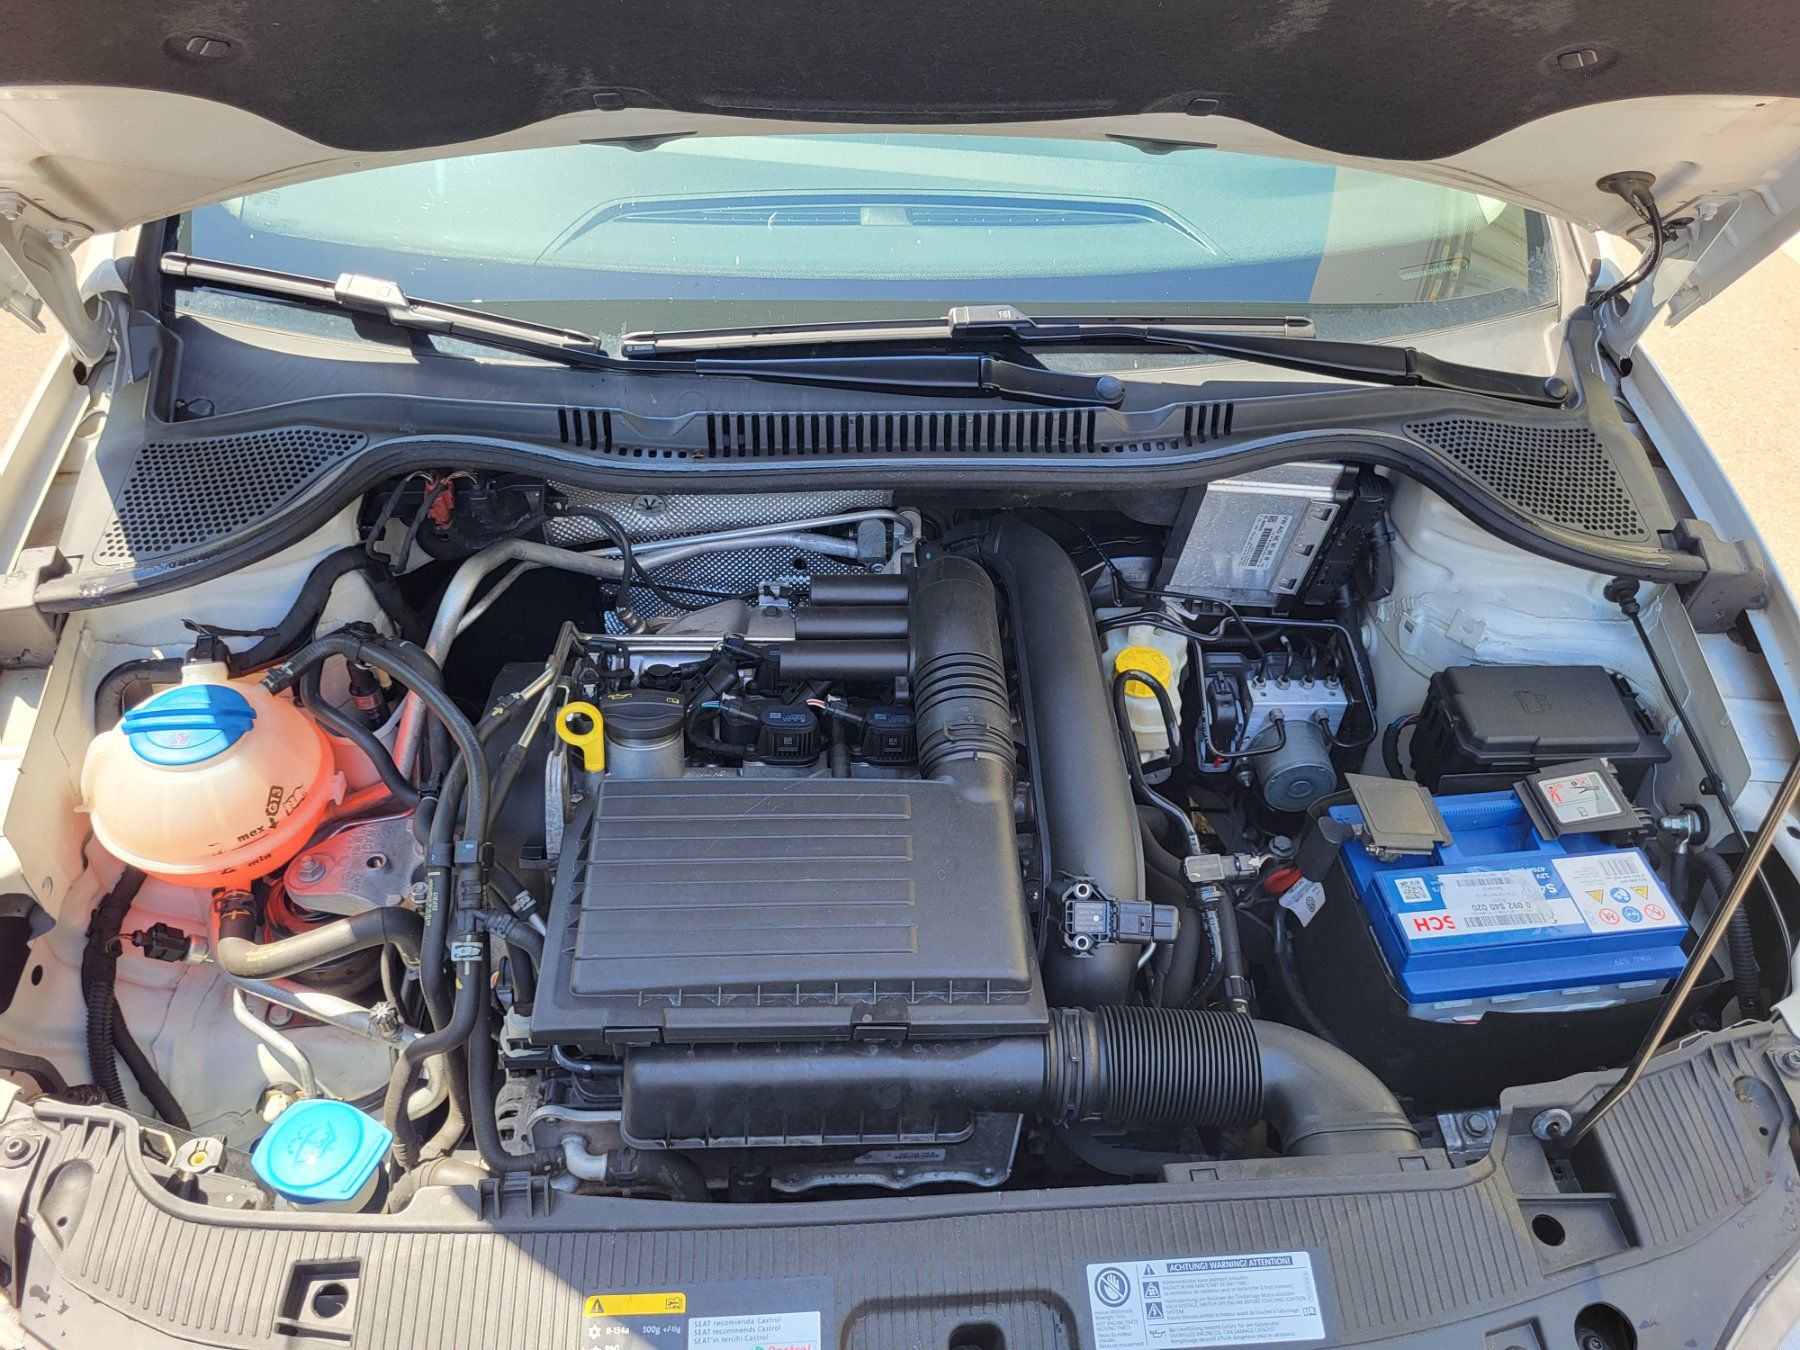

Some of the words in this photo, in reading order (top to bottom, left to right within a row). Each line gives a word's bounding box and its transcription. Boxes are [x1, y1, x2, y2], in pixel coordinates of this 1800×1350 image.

[237, 826, 265, 842] max
[248, 853, 272, 866] min
[1169, 1263, 1208, 1271] ACHTUNG!
[1210, 1261, 1248, 1269] WARNING!
[1249, 1257, 1290, 1267] ATTENTION!
[713, 1318, 754, 1326] recomienda
[642, 1326, 660, 1335] 500g
